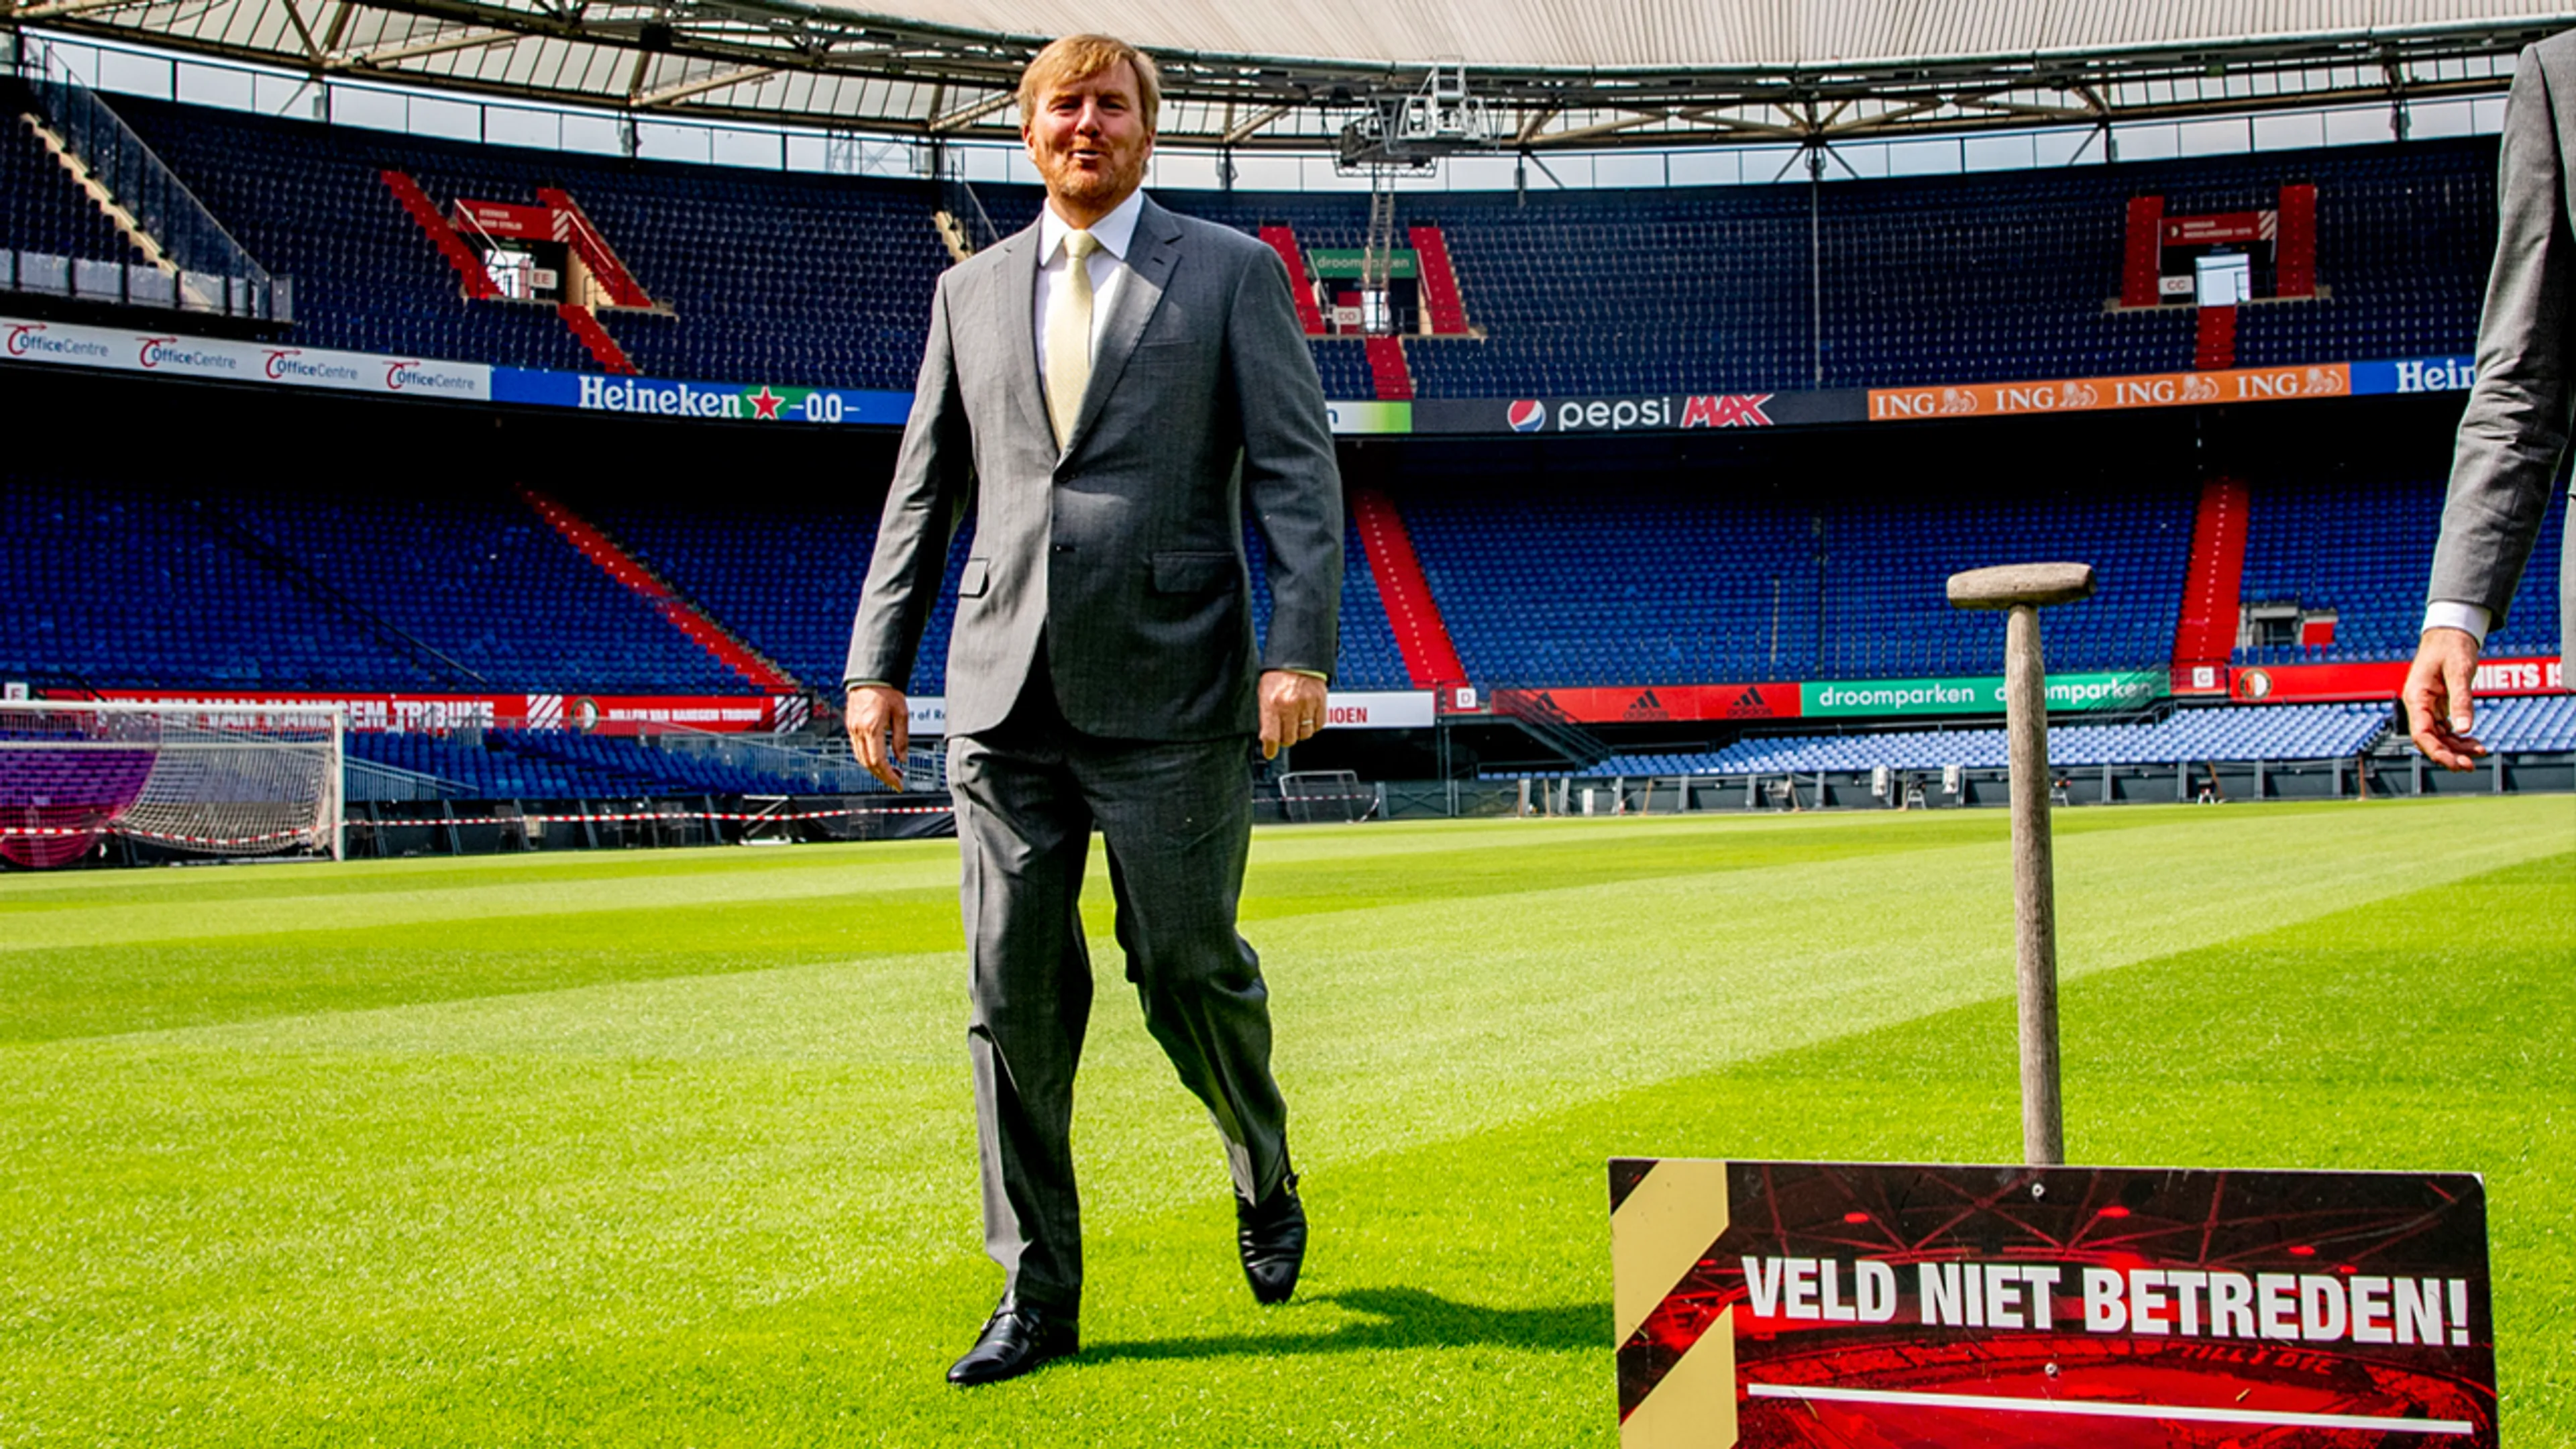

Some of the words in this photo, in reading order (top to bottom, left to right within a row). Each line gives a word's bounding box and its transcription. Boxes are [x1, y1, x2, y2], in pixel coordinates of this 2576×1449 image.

[532, 271, 550, 284] EE
[2166, 279, 2186, 291] CC
[1338, 311, 1356, 321] DD
[578, 376, 743, 418] Heineken
[1877, 394, 1935, 417] ING
[1996, 388, 2055, 411] ING
[2116, 381, 2176, 405] ING
[2238, 374, 2298, 398] ING
[1558, 396, 1671, 431] pepsi
[1678, 392, 1775, 428] MAX
[2197, 671, 2210, 684] C
[2471, 663, 2540, 690] NIETS
[1460, 692, 1471, 704] D
[1819, 684, 1975, 708] droomparken
[392, 700, 495, 728] TRIBUNE
[1623, 707, 1669, 720] adidas
[1727, 706, 1774, 718] adidas
[1741, 1256, 1897, 1322] VELD
[1918, 1262, 2061, 1330] NIET
[2082, 1267, 2469, 1346] BETREDEN!
